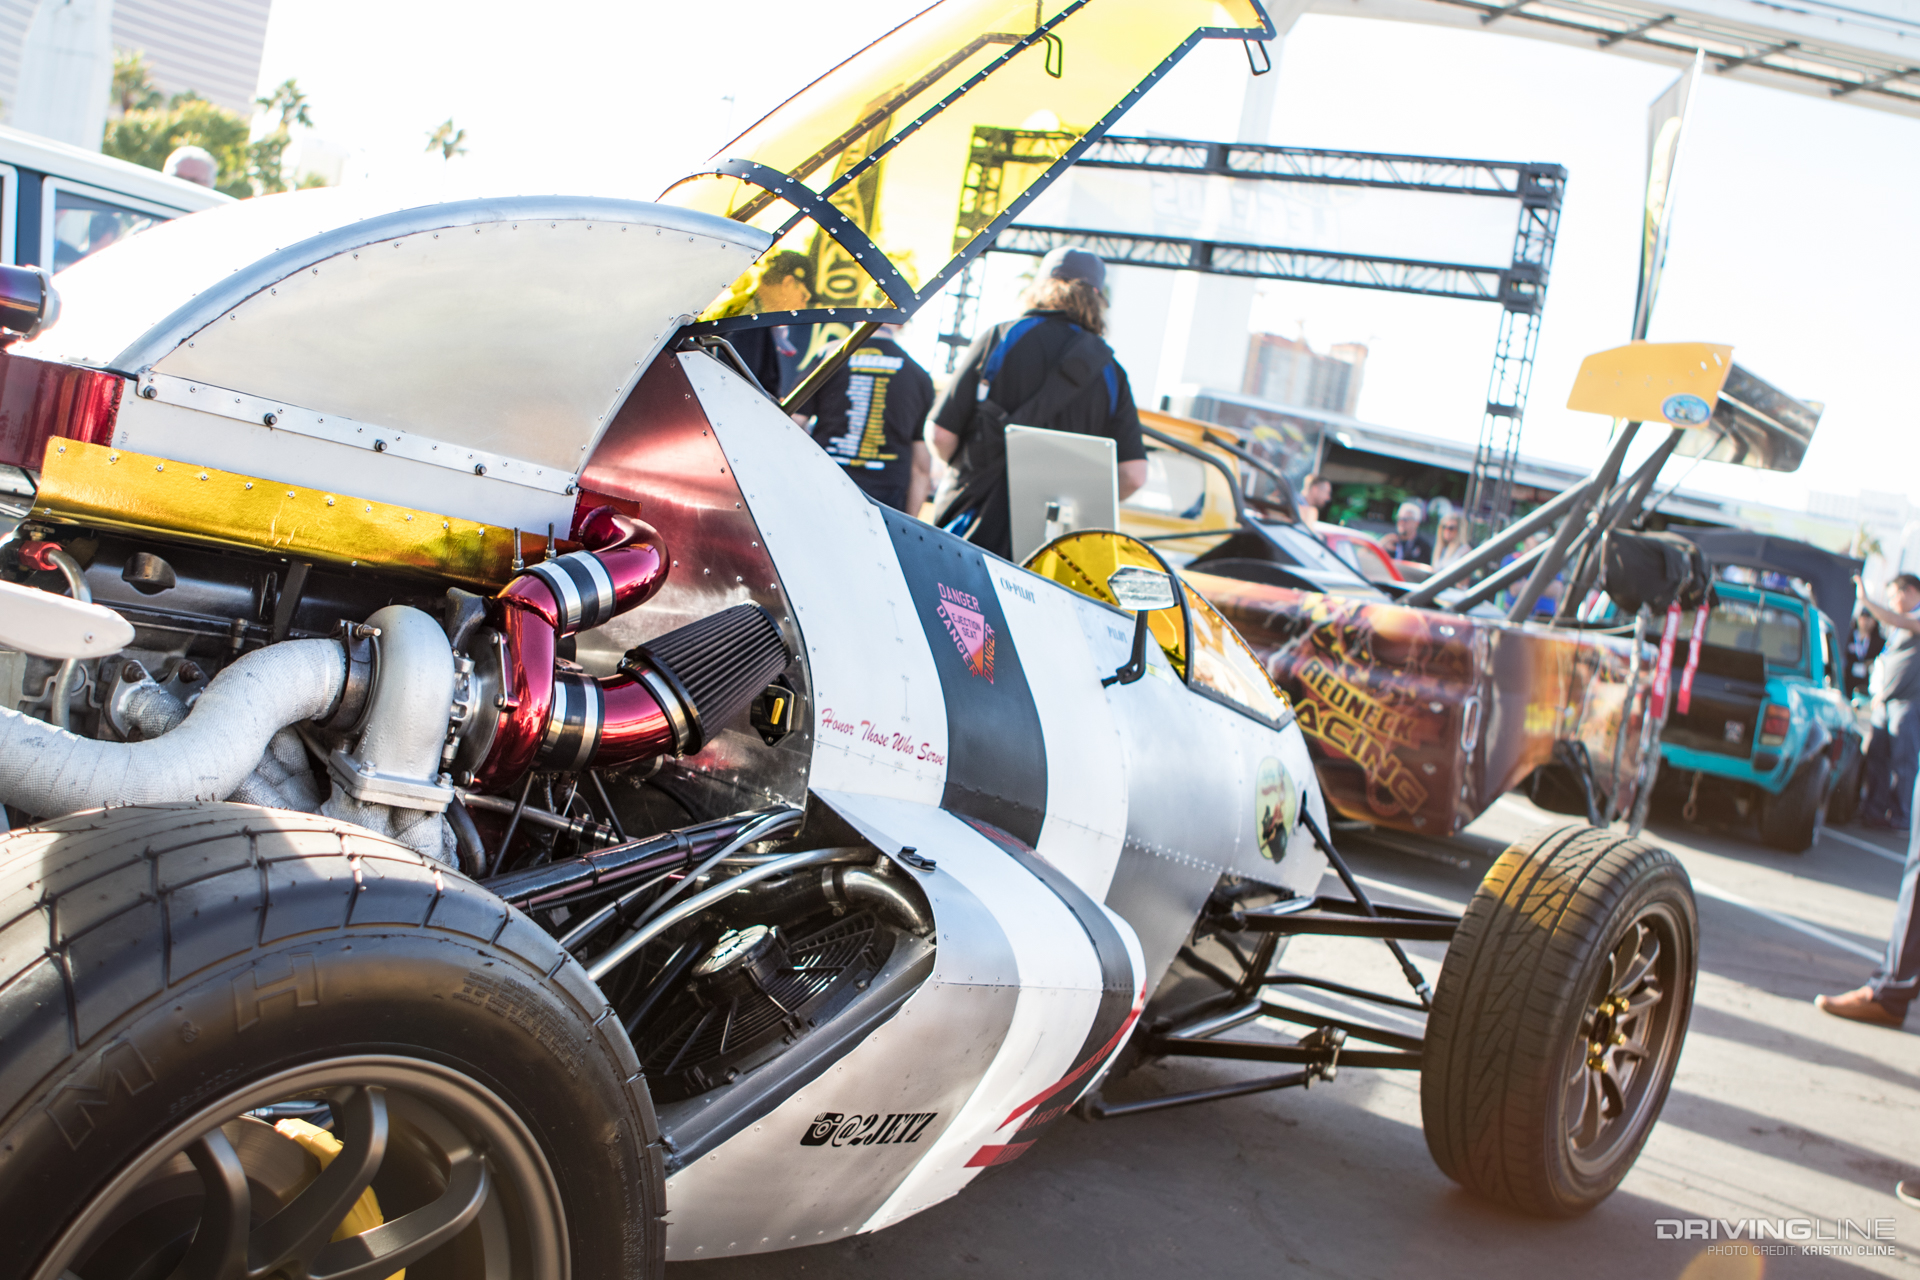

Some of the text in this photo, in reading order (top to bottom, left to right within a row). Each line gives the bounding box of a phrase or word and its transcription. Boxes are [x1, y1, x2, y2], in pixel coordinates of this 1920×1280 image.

[938, 582, 980, 612] DANGER
[951, 612, 982, 632] EJECTION
[936, 604, 978, 677] DANGER
[961, 626, 978, 641] SEAT
[984, 623, 995, 684] DANGER
[1302, 658, 1415, 744] REDNECK
[821, 708, 945, 766] Honor Those Who Serve
[1295, 697, 1428, 815] ACING
